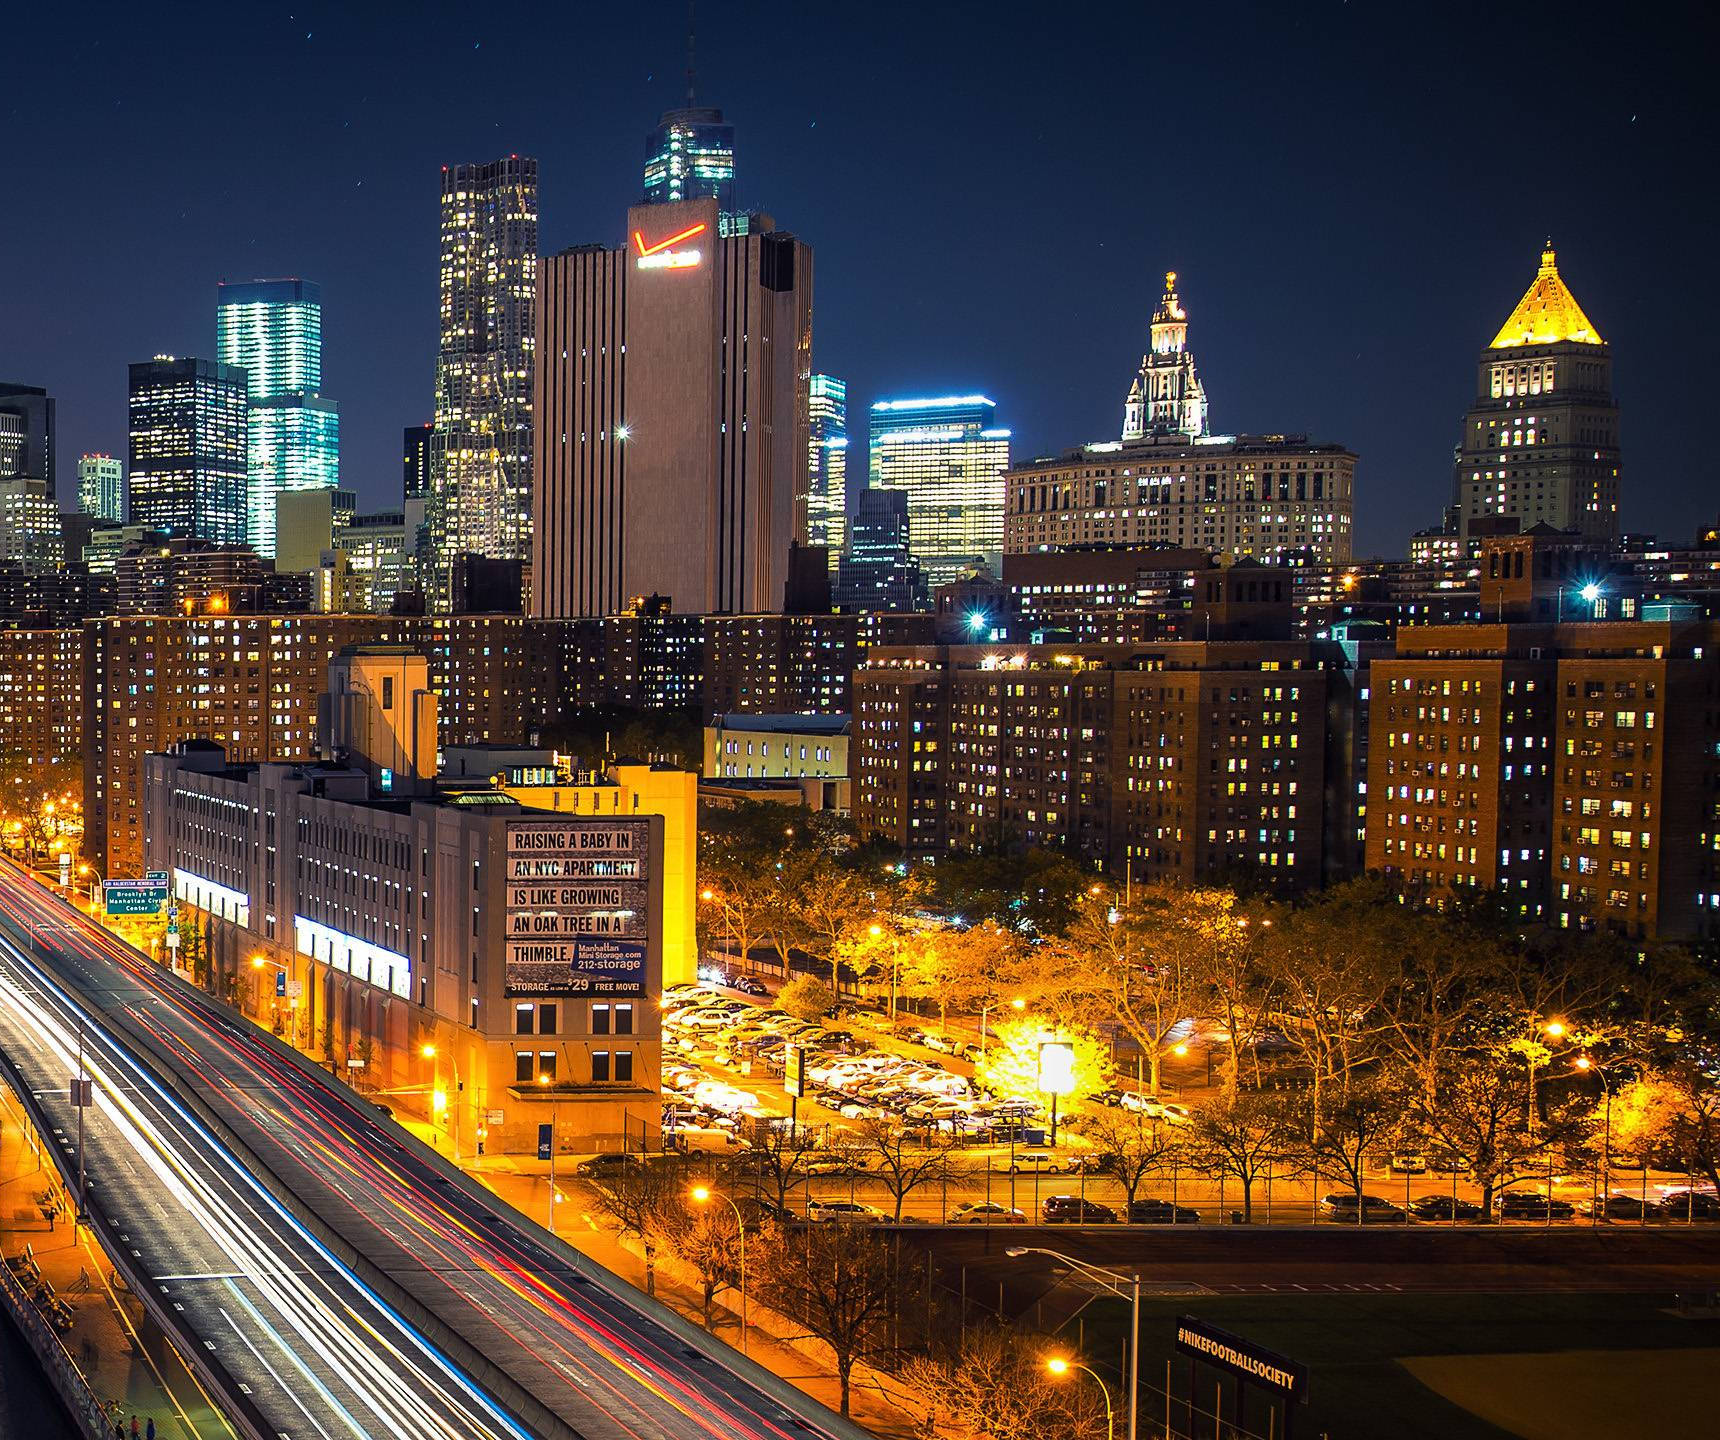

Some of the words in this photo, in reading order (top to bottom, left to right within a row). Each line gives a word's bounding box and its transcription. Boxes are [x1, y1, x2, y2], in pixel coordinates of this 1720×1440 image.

[515, 833, 565, 849] RAISING
[569, 833, 577, 848] A
[580, 833, 612, 848] BABY
[616, 833, 629, 848] IN
[515, 860, 531, 876] AN
[535, 860, 559, 876] NYC
[563, 860, 637, 876] APARTMENT
[514, 889, 526, 905] IS
[530, 889, 557, 905] LIKE
[561, 889, 619, 905] GROWING
[514, 917, 530, 932] AN
[534, 917, 559, 932] OAK
[562, 917, 592, 932] TREE
[596, 917, 609, 932] IN
[613, 917, 621, 932] A
[513, 946, 571, 961] THIMBLE.
[578, 942, 620, 952] Manhattan
[511, 982, 549, 991] STORAGE
[567, 978, 589, 991] $29
[595, 983, 614, 991] FREE
[615, 983, 640, 991] MOVE!
[1178, 1327, 1295, 1390] #NIKEFOOTBALLSOCIETY
